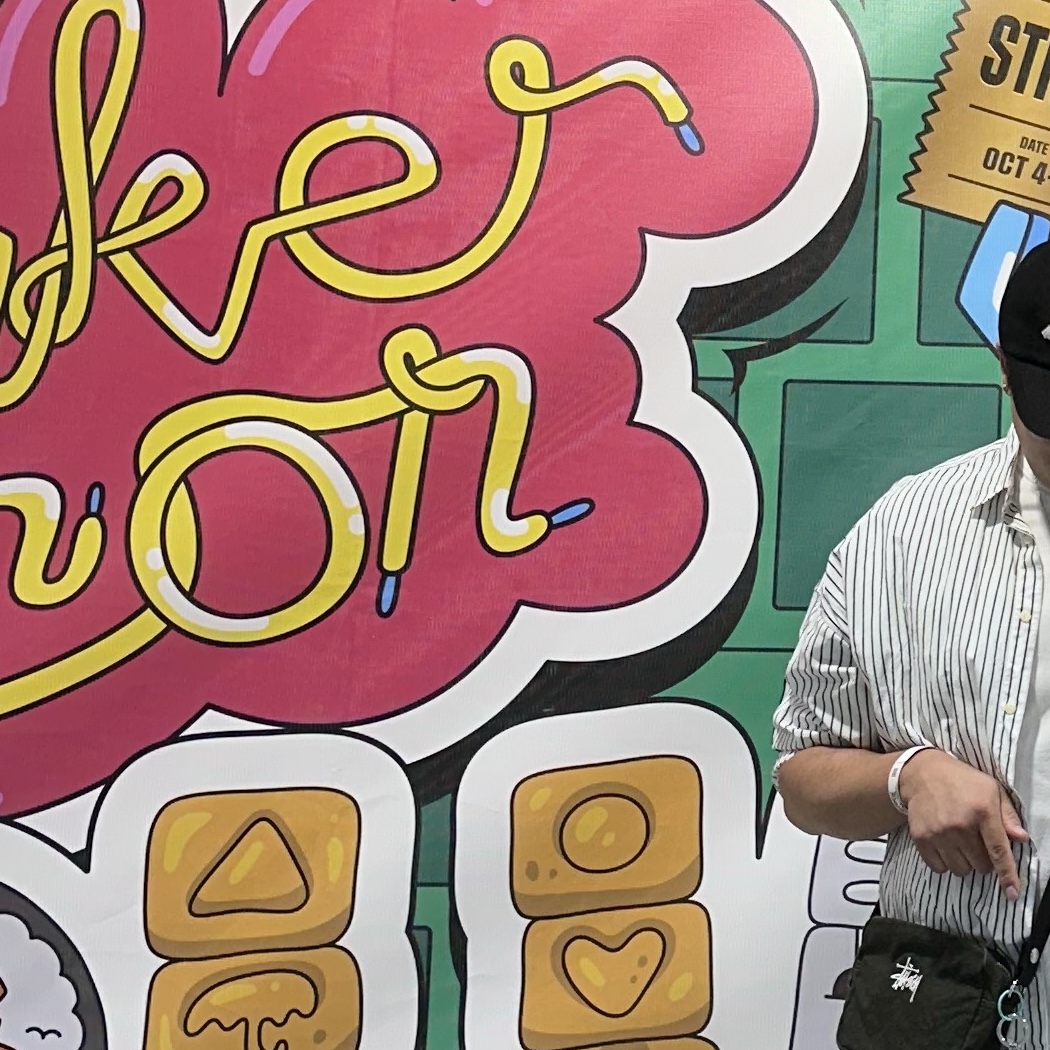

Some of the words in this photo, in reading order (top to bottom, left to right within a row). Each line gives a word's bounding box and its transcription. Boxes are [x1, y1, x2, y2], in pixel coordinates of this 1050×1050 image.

[1019, 136, 1050, 156] DATE
[982, 147, 1031, 179] OCT
[0, 0, 704, 412] ker
